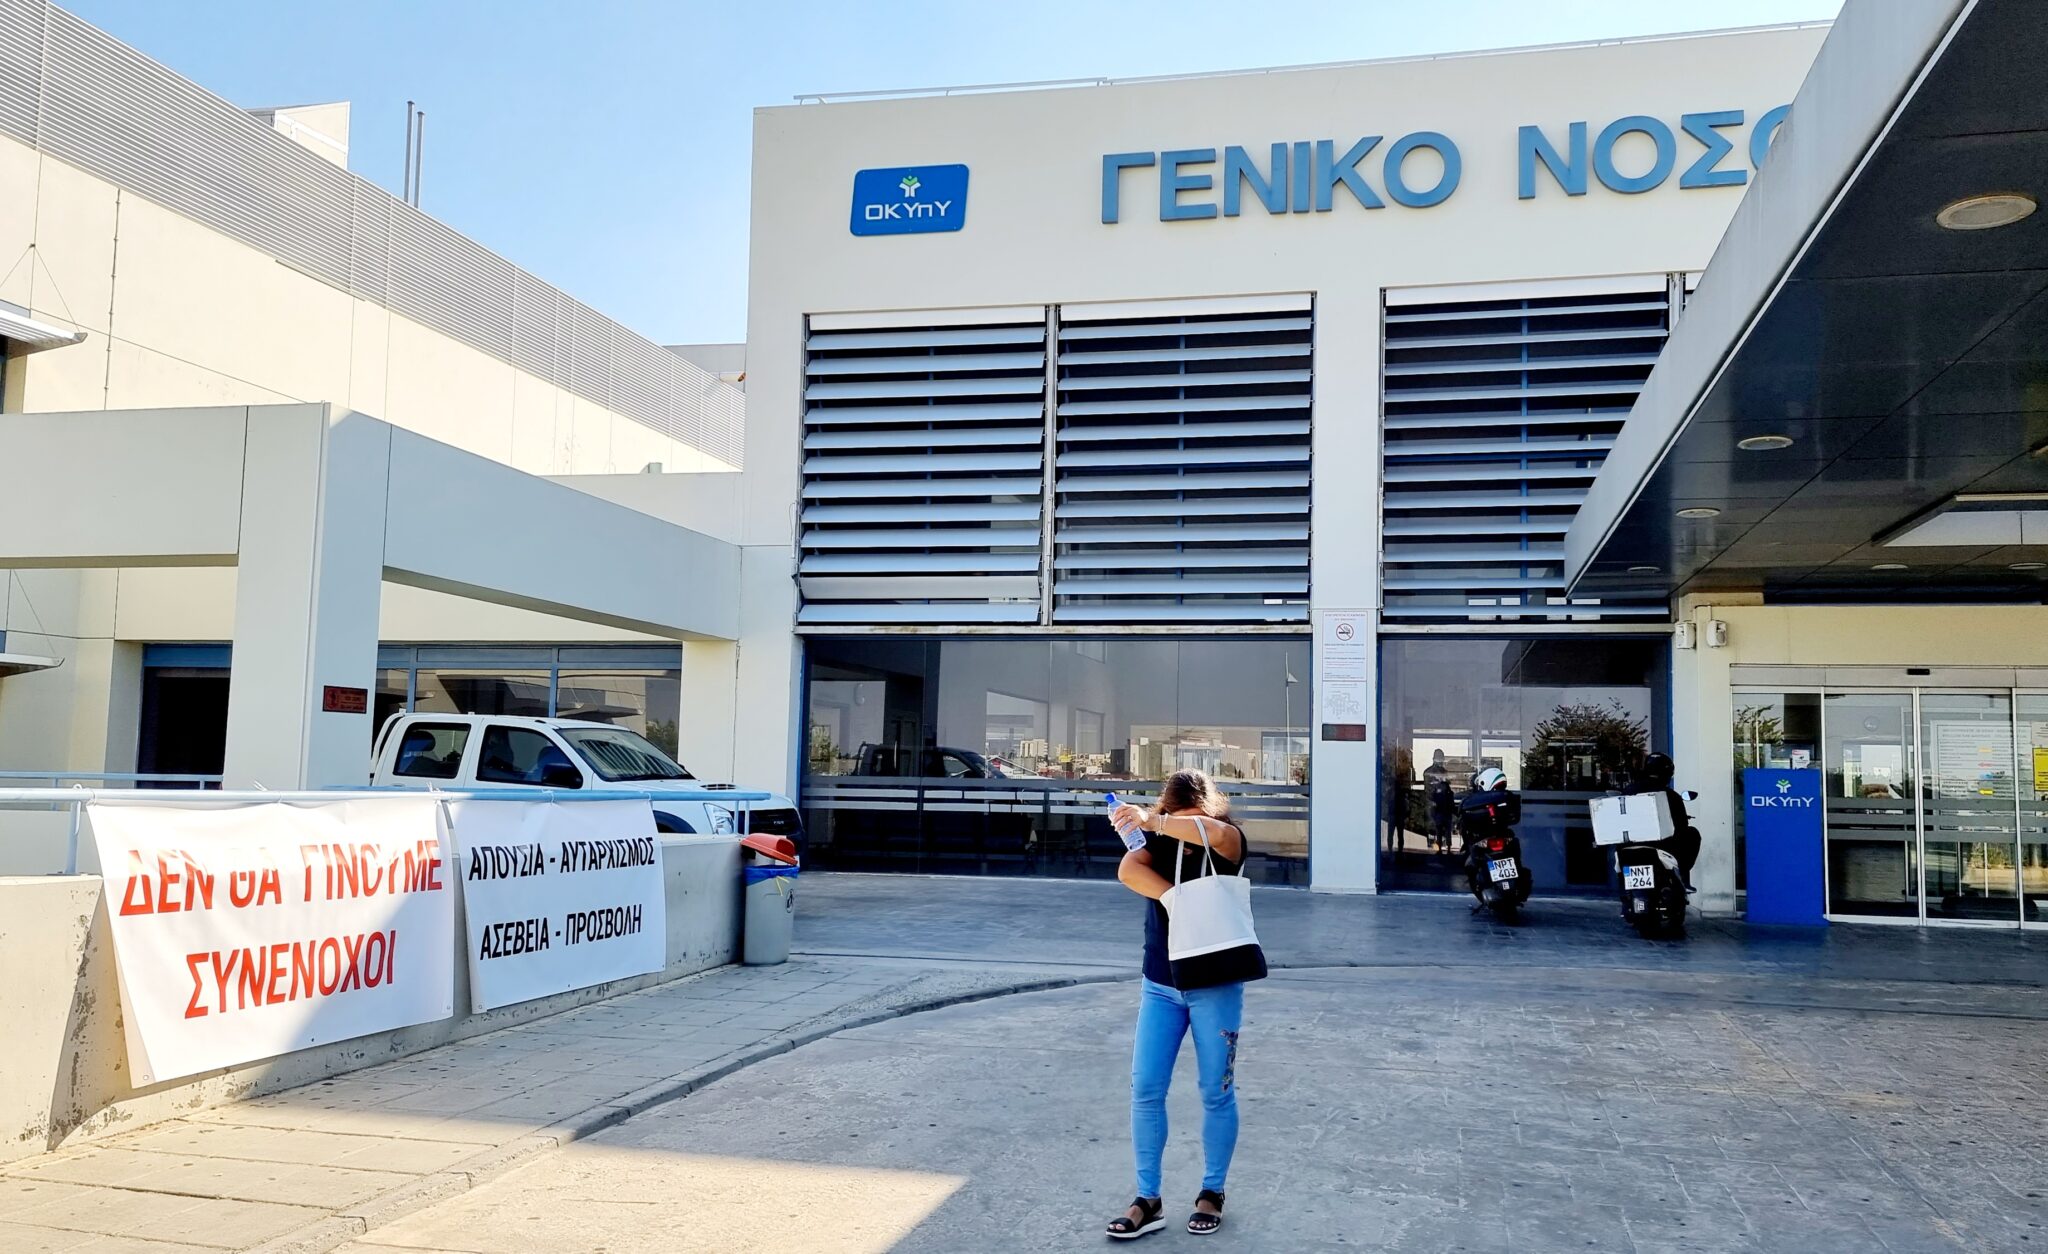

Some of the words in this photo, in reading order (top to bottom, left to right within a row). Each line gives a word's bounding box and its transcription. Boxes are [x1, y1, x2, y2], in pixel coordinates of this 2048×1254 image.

[1102, 131, 1462, 224] ΓΕΝΙΚΟ
[119, 849, 215, 916] ΔΕΝ
[300, 839, 443, 902] ΓΙΝΟΥΜΕ
[468, 842, 545, 881] ΑΠΟΥΣΙΑ
[560, 836, 655, 873] ΑΥΤΑΡΧΙΣΜΟΣ
[1493, 858, 1513, 870] NPT
[1498, 868, 1517, 878] 403
[1630, 866, 1651, 877] NNT
[1632, 877, 1652, 888] 264
[479, 917, 550, 960] ΑΣΕΒΕΙΑ
[565, 904, 643, 946] ΠΡΟΣΒΟΛΗ
[184, 929, 396, 1019] ΣΥΝΕΝΟΧΟΙ
